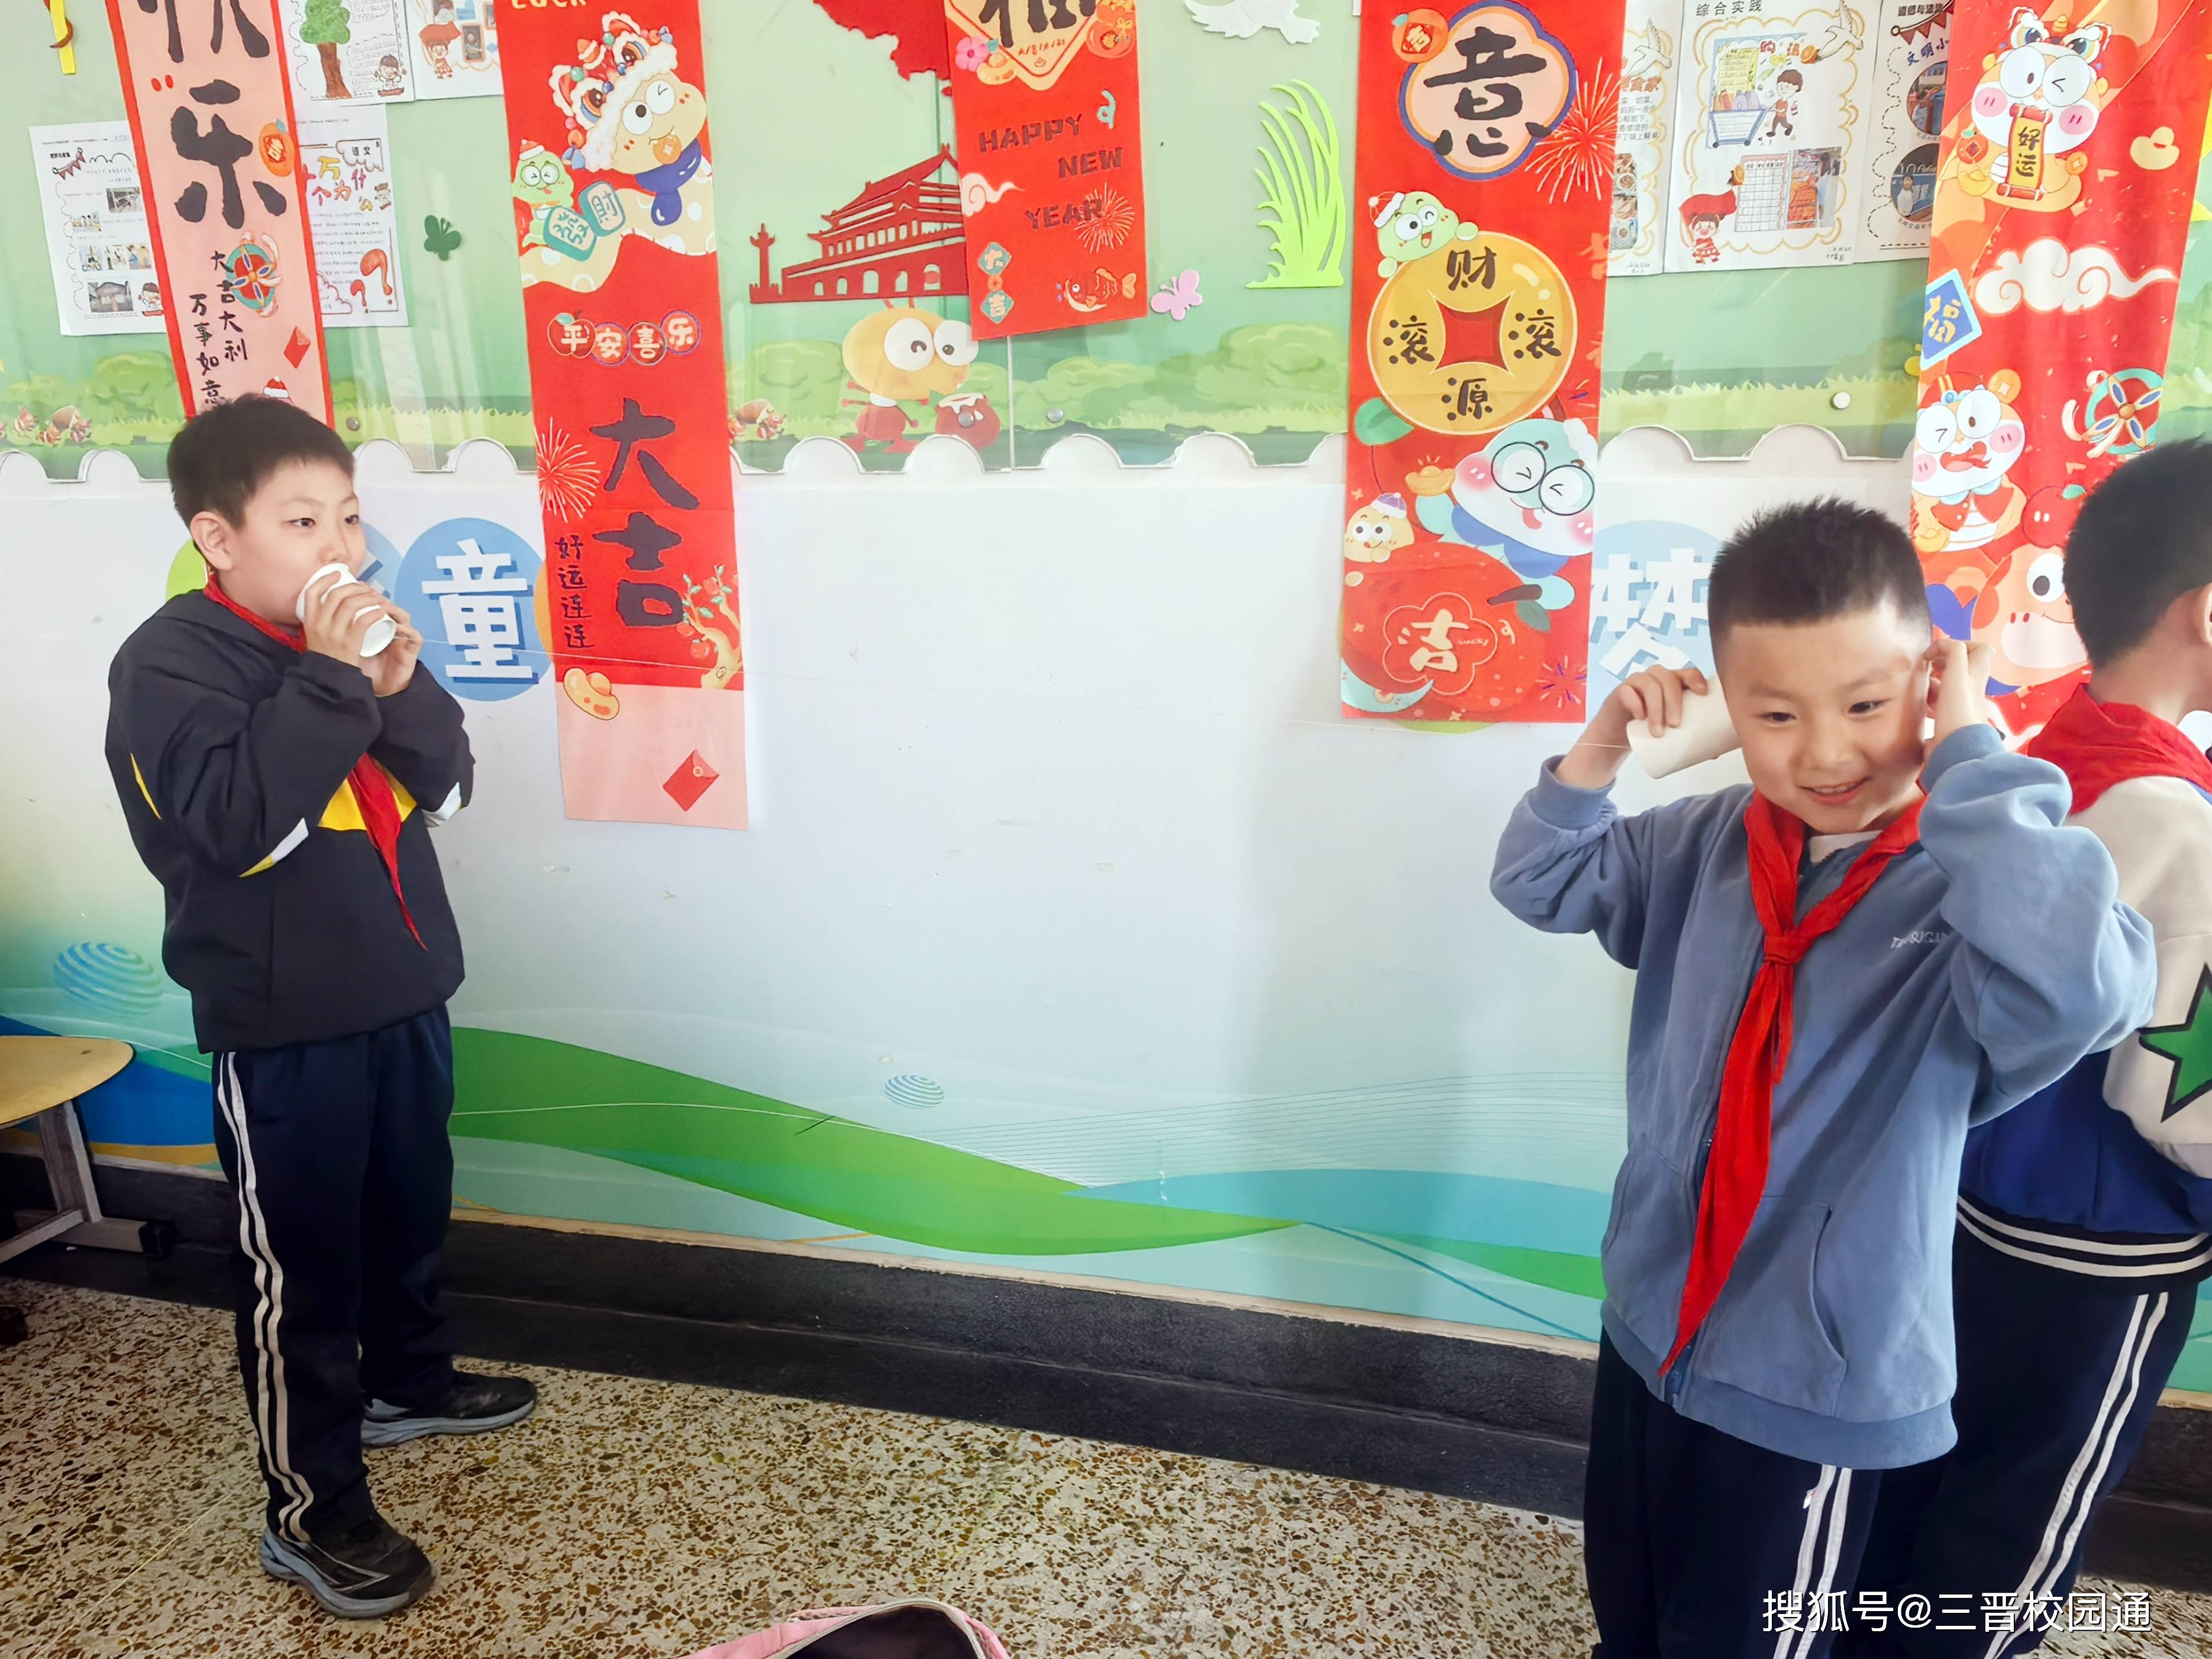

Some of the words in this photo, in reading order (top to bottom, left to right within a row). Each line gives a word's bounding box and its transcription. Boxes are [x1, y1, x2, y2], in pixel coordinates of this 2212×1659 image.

[1696, 0, 1762, 17] 综合实践
[1423, 27, 1553, 157] 意
[979, 114, 1082, 153] HAPPY
[2016, 126, 2040, 177] 好运
[1058, 147, 1123, 179] NEW
[1024, 196, 1104, 231] YEAR
[1446, 247, 1497, 290] 财
[211, 250, 248, 362] 大吉大利
[189, 293, 227, 404] 万事如意
[560, 317, 695, 359] 平安喜乐
[1383, 315, 1435, 364] 滚
[1507, 309, 1562, 359] 滚
[1441, 377, 1493, 420] 源
[590, 397, 700, 627] 大吉
[422, 538, 537, 679] 童
[554, 534, 595, 649] 好运连连
[1409, 608, 1470, 673] 吉
